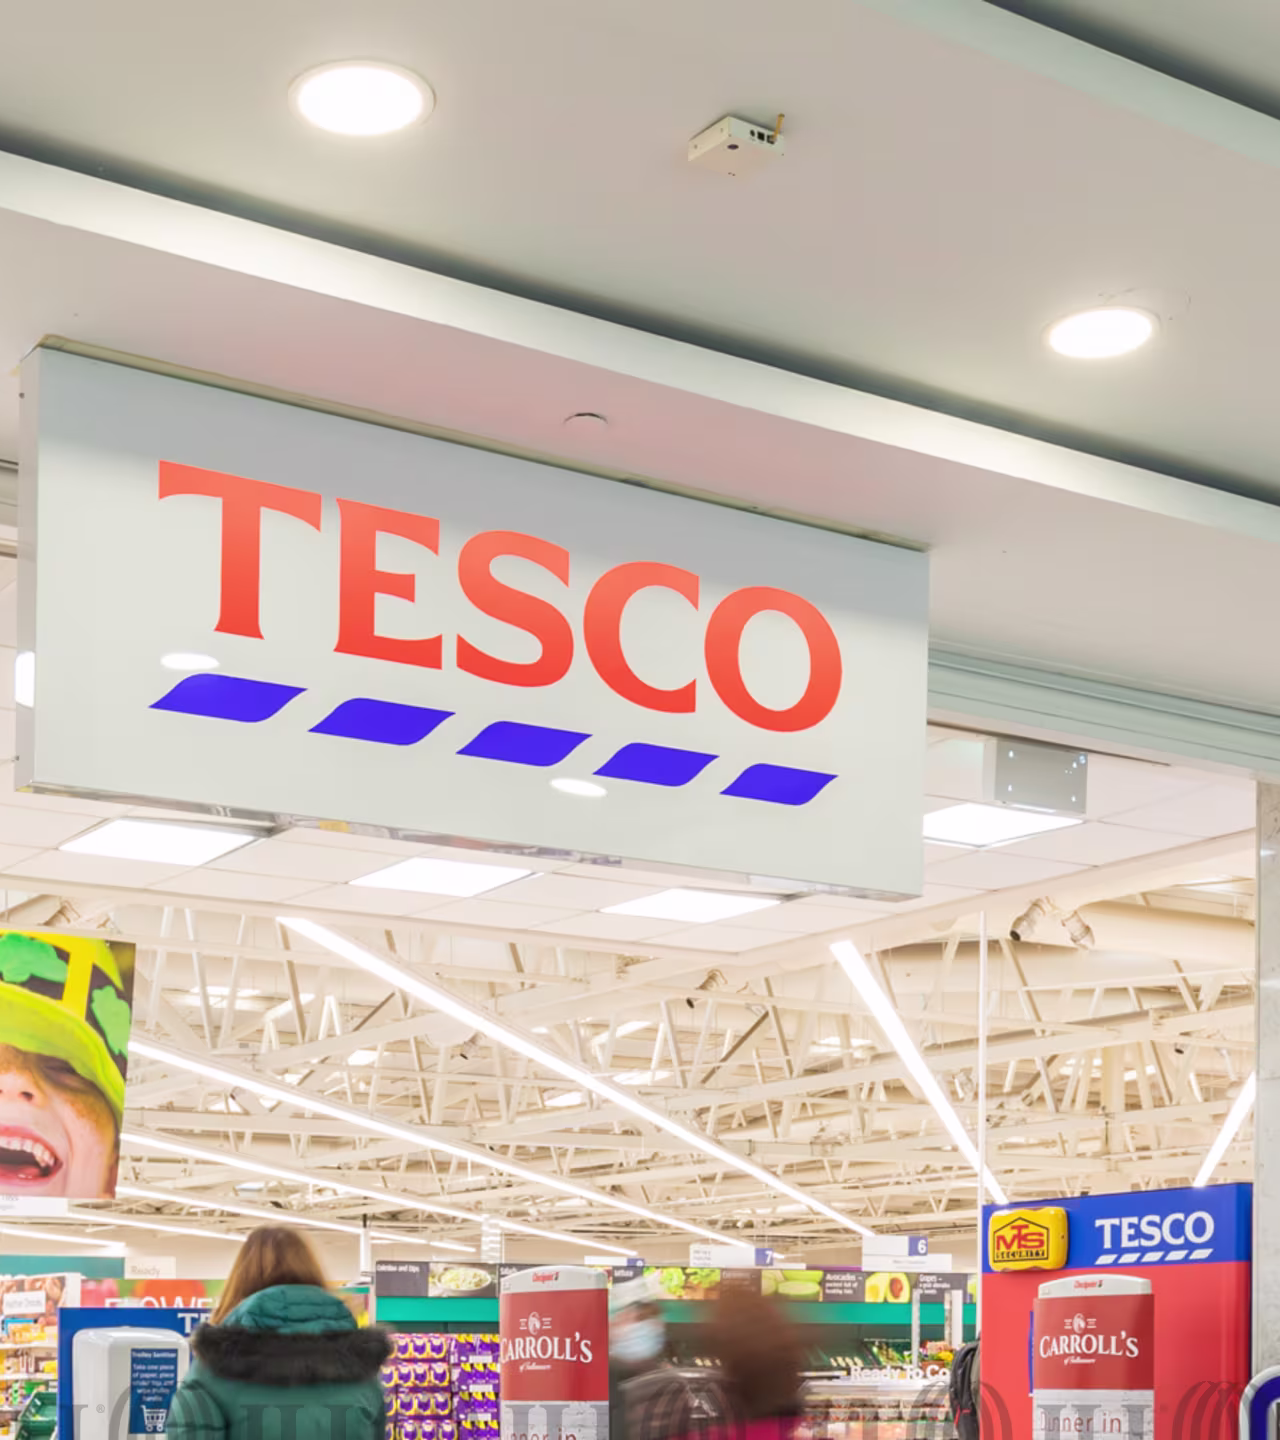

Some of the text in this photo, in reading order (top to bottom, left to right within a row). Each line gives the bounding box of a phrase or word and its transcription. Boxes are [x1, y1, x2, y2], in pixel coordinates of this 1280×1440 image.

[158, 460, 843, 732] TESCO
[996, 1224, 1045, 1250] MTS
[1094, 1211, 1214, 1249] TESCO
[765, 1250, 773, 1263] 7
[918, 1239, 927, 1254] 6
[500, 1331, 593, 1363] CARROLL'S
[1039, 1330, 1139, 1358] CARROLL'S
[850, 1365, 950, 1380] Ready To Co
[1040, 1412, 1121, 1433] Dinner in
